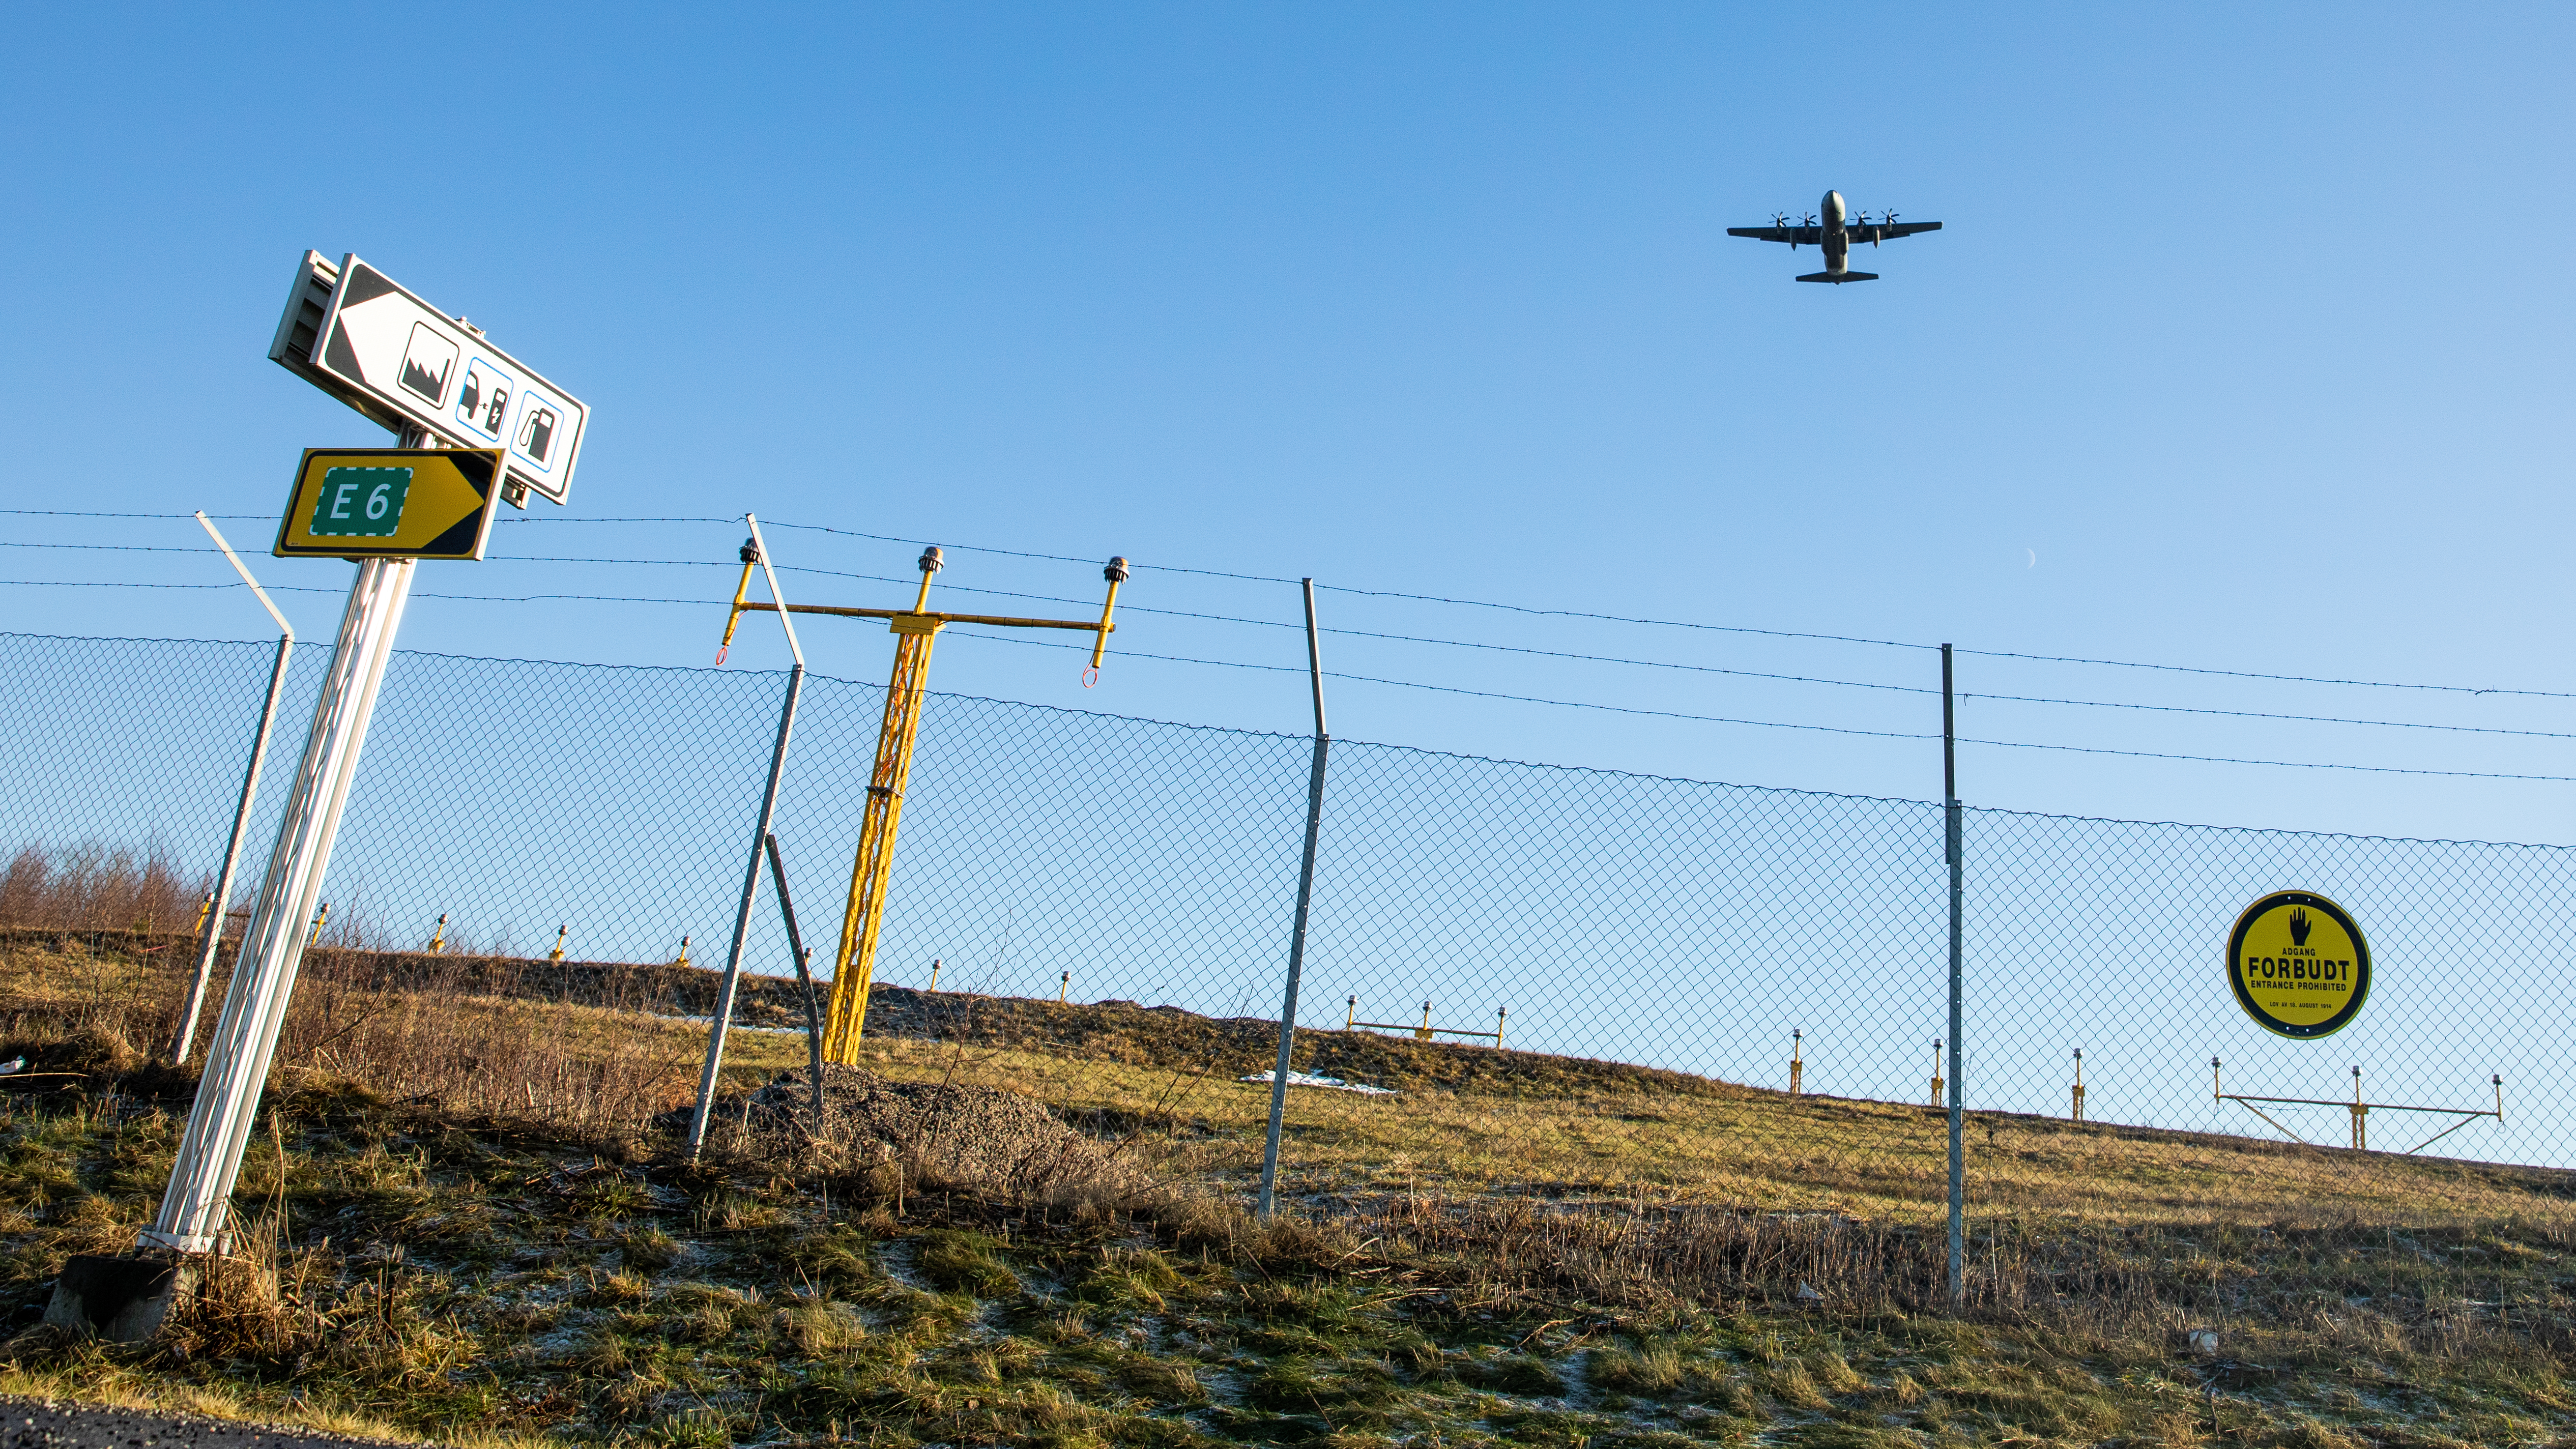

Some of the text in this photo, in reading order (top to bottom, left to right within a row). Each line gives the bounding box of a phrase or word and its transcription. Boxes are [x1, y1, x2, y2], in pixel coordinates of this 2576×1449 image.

[330, 483, 391, 519] E 6
[2282, 947, 2315, 956] ADGANG
[2248, 957, 2350, 980] FORBUDT
[2251, 980, 2346, 991] ENTRANCE PROHIBITED
